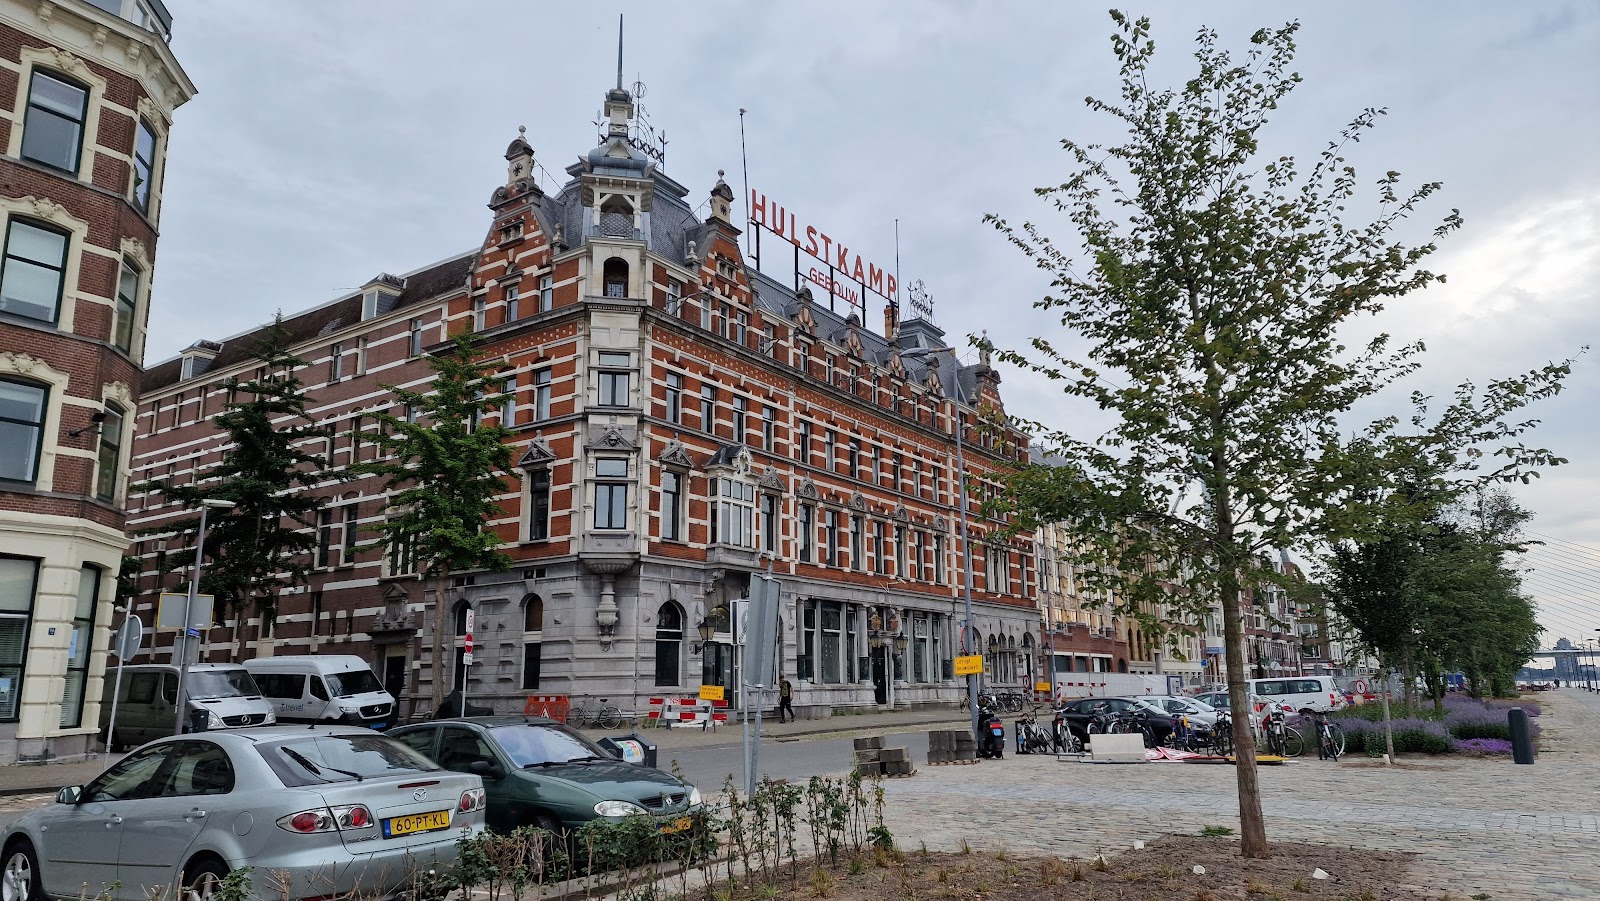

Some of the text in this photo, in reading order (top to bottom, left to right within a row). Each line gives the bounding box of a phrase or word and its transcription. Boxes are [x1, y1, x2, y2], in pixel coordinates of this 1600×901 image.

[751, 188, 897, 300] HULSTKAMP
[810, 267, 858, 305] GEBOUW
[396, 814, 446, 832] 60-PT-KL
